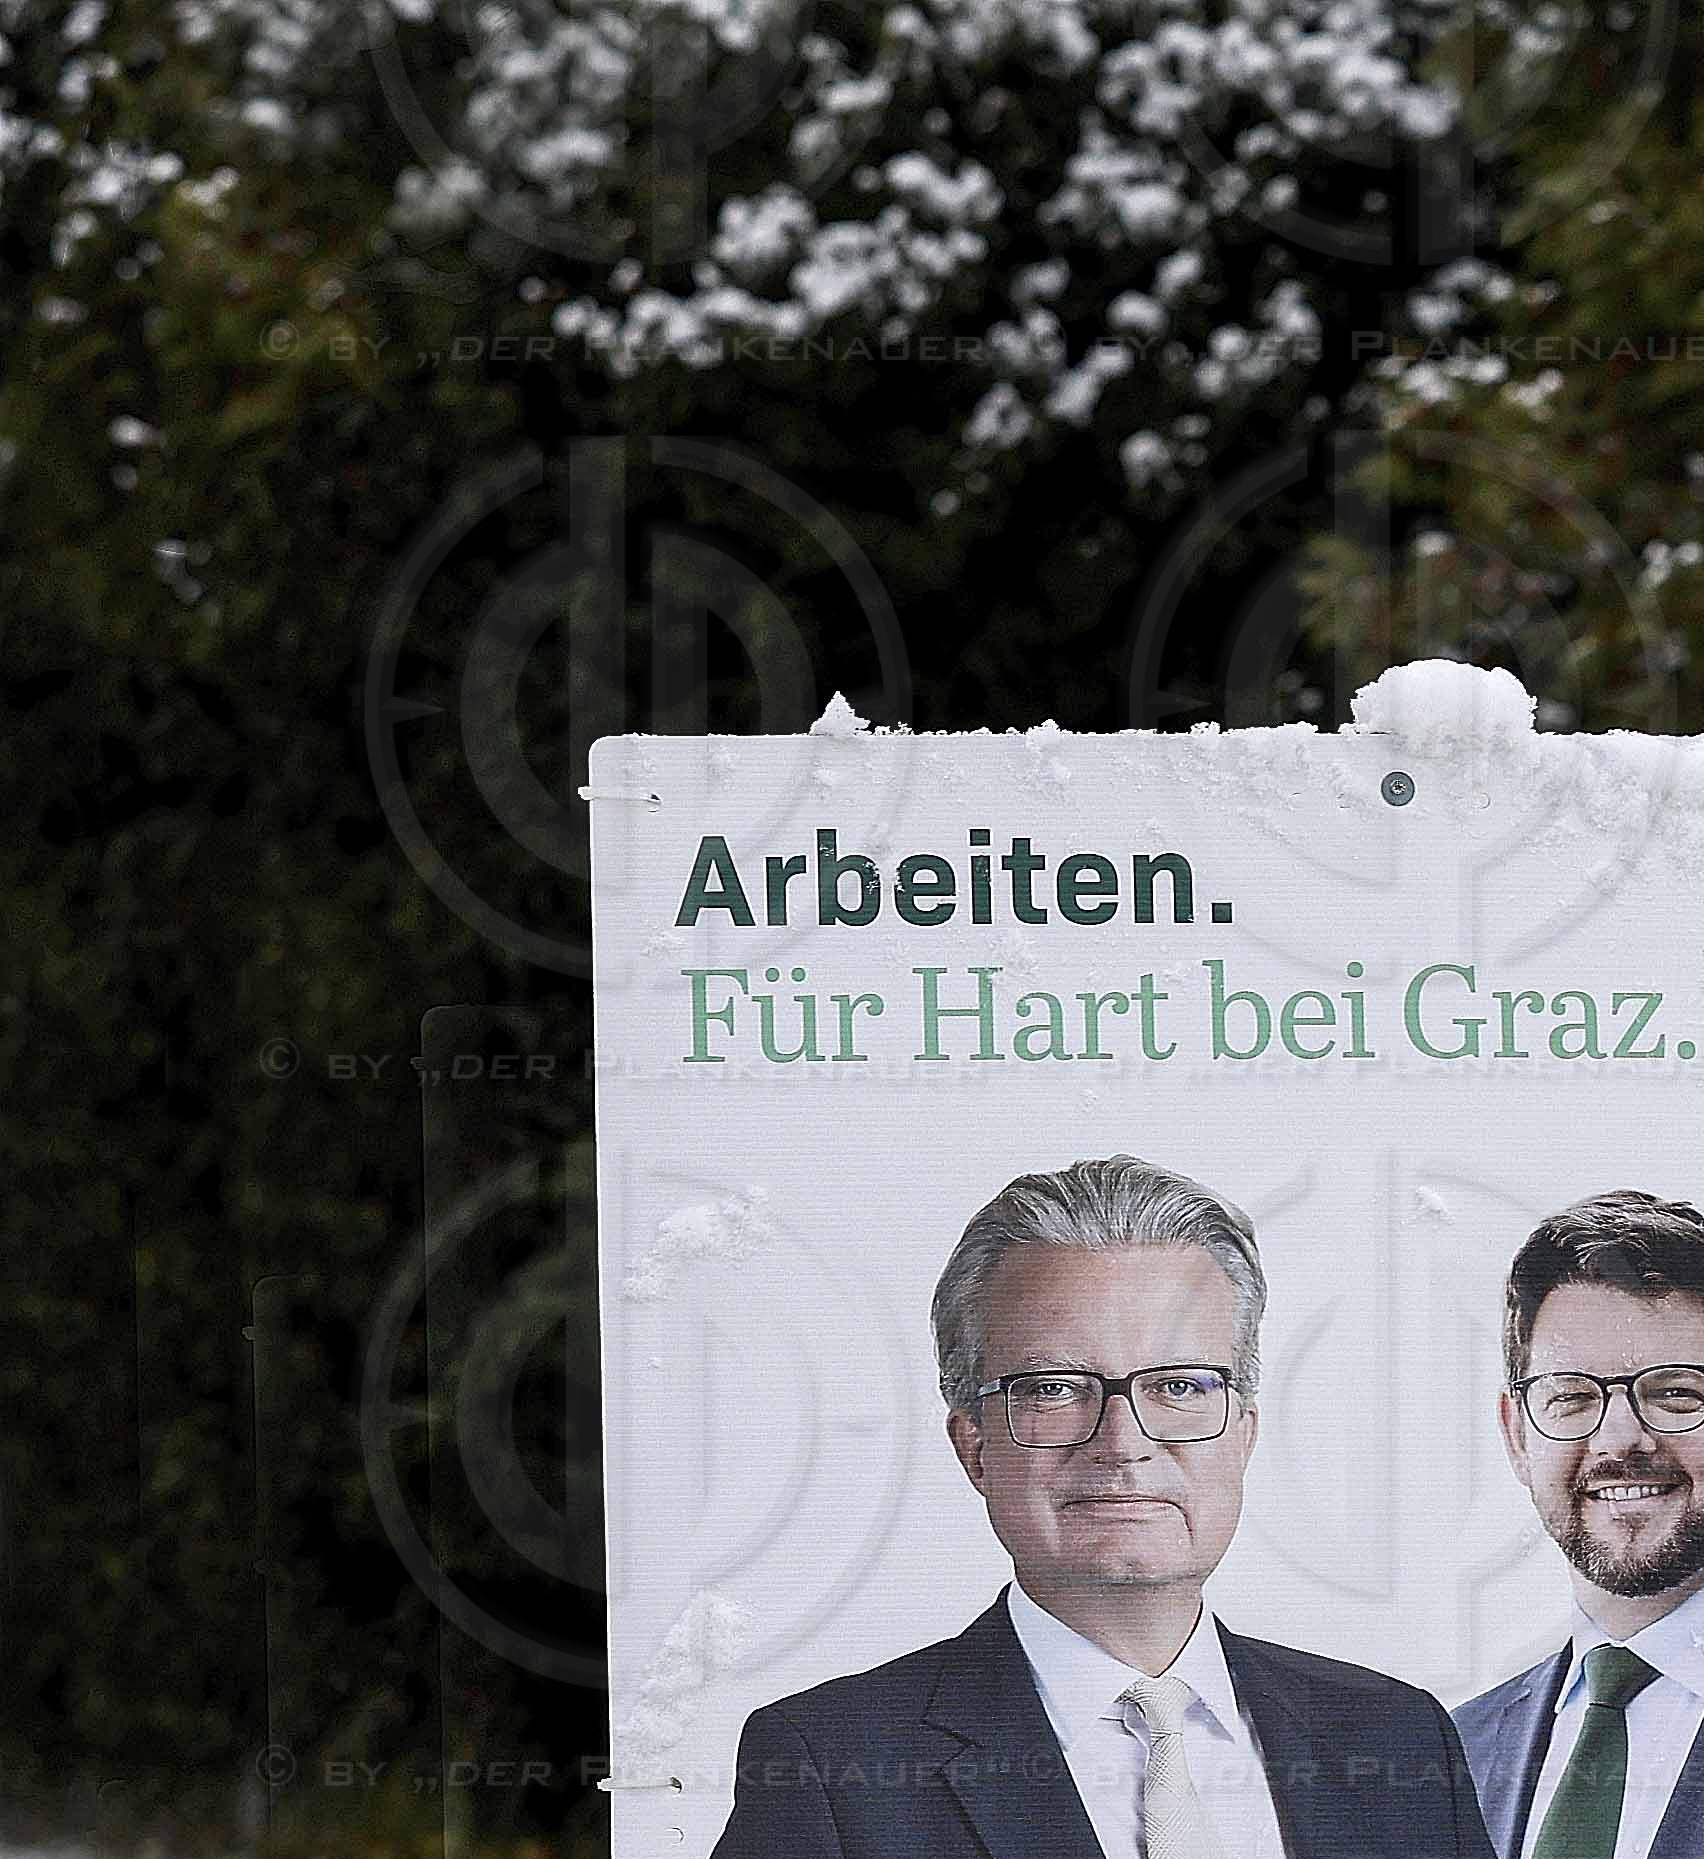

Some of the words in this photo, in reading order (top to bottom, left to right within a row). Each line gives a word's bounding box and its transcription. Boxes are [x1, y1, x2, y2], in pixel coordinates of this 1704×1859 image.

[673, 827, 1234, 927] Arbeiten.
[680, 966, 885, 1063] Für
[911, 966, 1178, 1062] Hart
[1201, 959, 1376, 1060] bei
[1403, 963, 1698, 1060] Graz.
